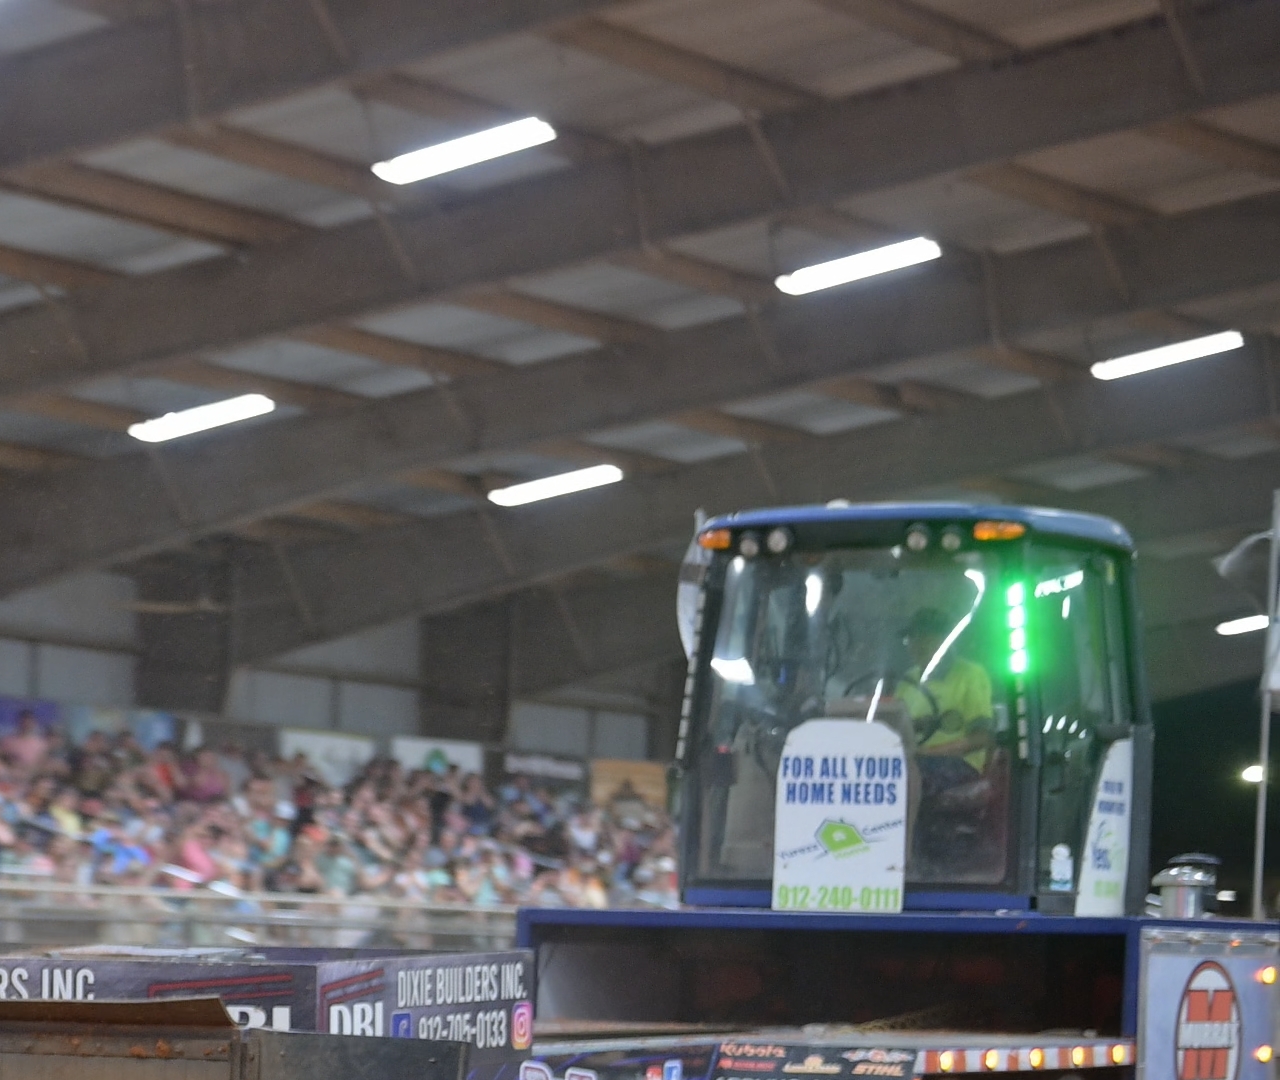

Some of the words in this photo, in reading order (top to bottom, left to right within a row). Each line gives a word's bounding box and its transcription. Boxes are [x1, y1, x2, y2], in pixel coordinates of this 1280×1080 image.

[782, 757, 814, 779] FOR
[819, 757, 847, 779] ALL
[854, 757, 902, 779] YOUR
[786, 782, 835, 804] HOME
[841, 783, 897, 805] NEEDS
[778, 884, 901, 909] 912-240-0111
[397, 968, 433, 1008] DIXIE
[435, 963, 499, 1005] BUILDERS
[500, 961, 529, 1000] INC.
[719, 1043, 786, 1058] Kubota
[851, 1063, 905, 1077] STIHL
